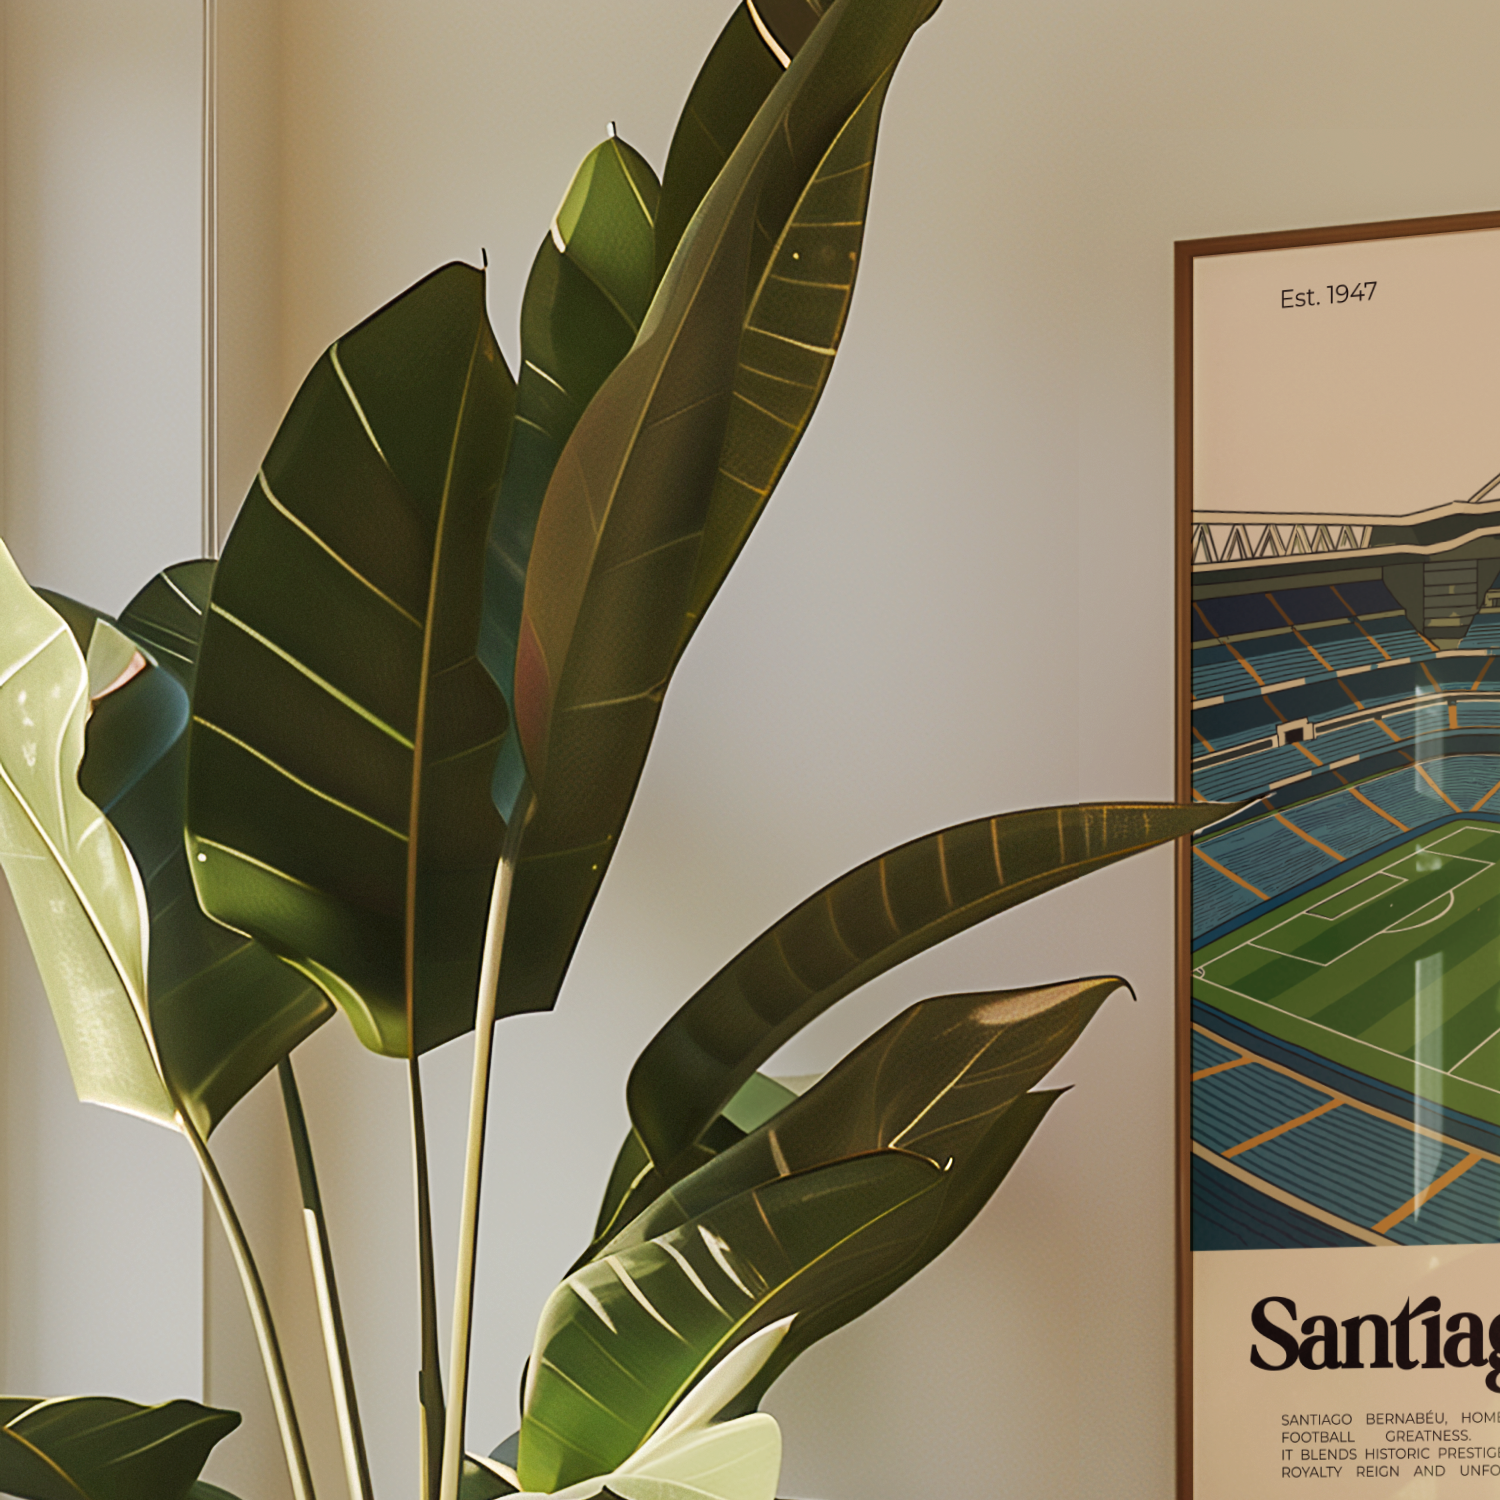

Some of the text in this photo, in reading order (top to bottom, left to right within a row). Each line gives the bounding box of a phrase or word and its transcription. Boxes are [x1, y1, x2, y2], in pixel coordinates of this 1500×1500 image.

[1281, 280, 1378, 309] Est. 1947
[1281, 1413, 1353, 1427] SANTIAGO
[1366, 1409, 1448, 1426] BERNABÉU,
[1281, 1430, 1356, 1444] FOOTBALL
[1385, 1429, 1472, 1443] GREATNESS.
[1281, 1448, 1294, 1461] IT
[1300, 1447, 1358, 1461] BLENDS
[1365, 1447, 1430, 1460] HISTORIC
[1281, 1465, 1343, 1479] ROYALTY
[1356, 1465, 1400, 1478] REIGN
[1413, 1464, 1446, 1477] AND
